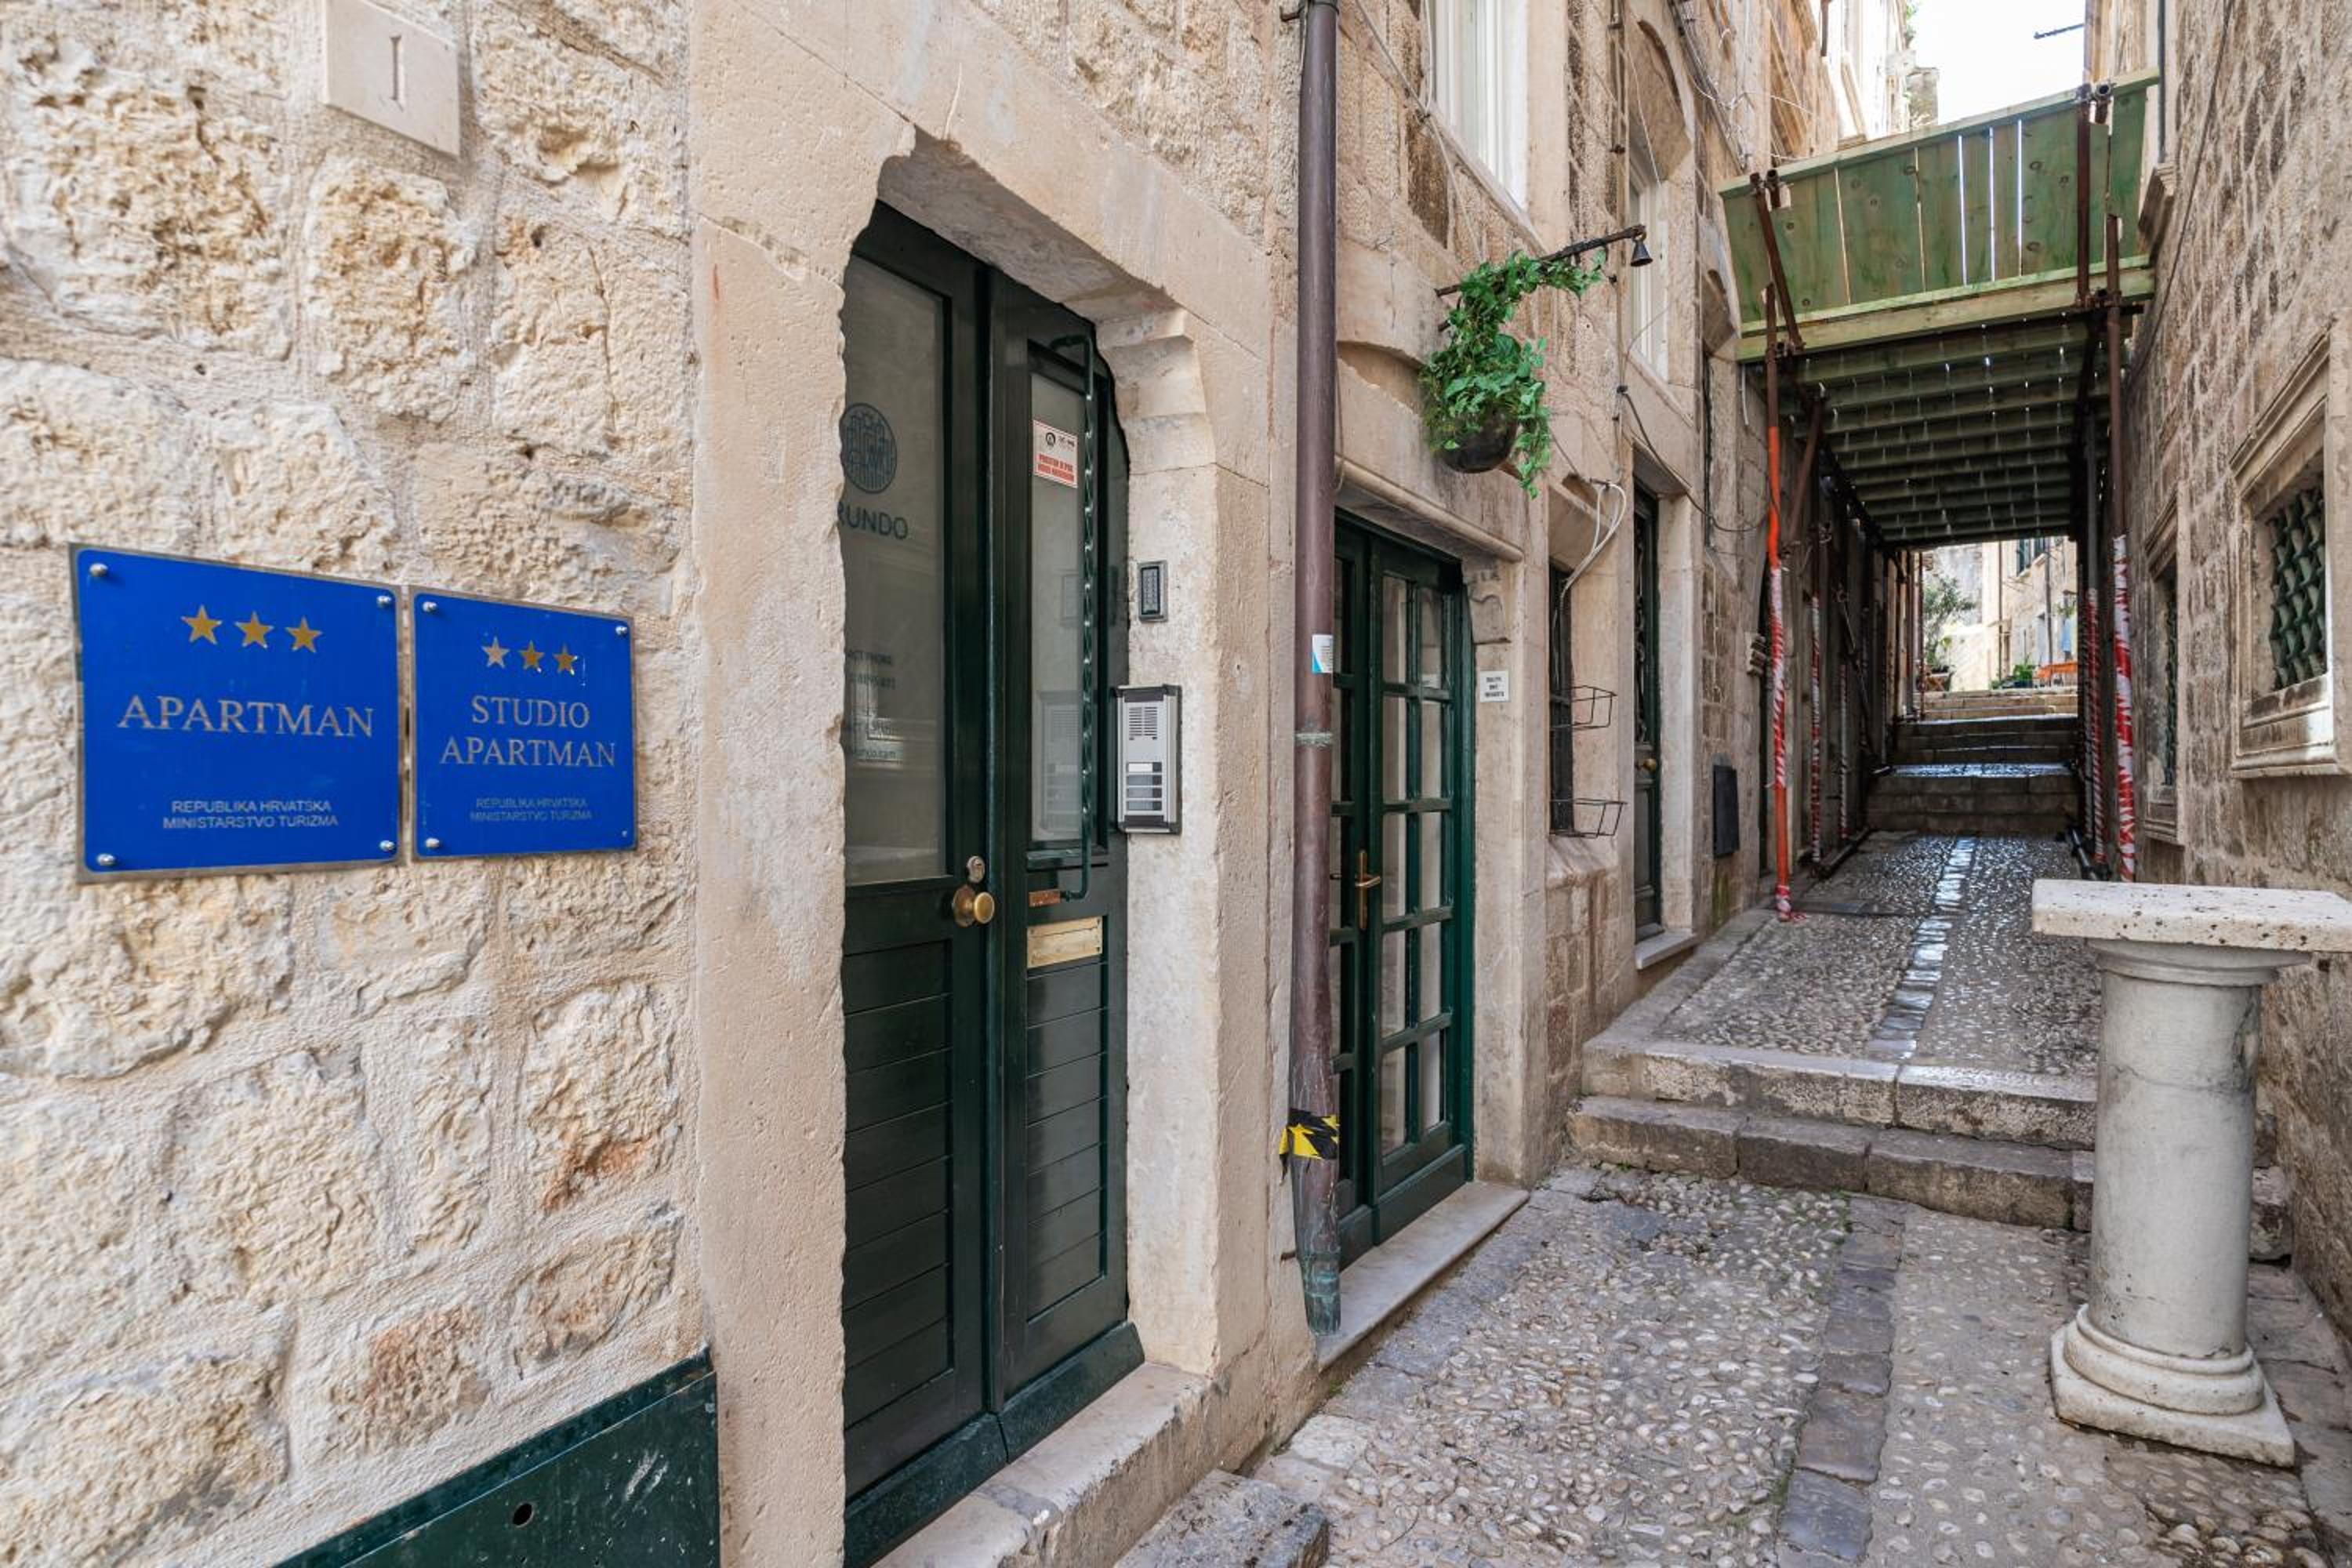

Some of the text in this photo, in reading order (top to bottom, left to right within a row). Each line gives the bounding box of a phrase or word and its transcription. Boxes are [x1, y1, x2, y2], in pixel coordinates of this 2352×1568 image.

[837, 502, 909, 540] RUNDO
[118, 694, 374, 739] APARTMAN
[471, 695, 590, 728] STUDIO
[439, 735, 615, 768] APARTMAN
[163, 815, 338, 829] MINISTARSTVO TURIZMA
[171, 800, 332, 814] REPUBLIKA HRVATSKA
